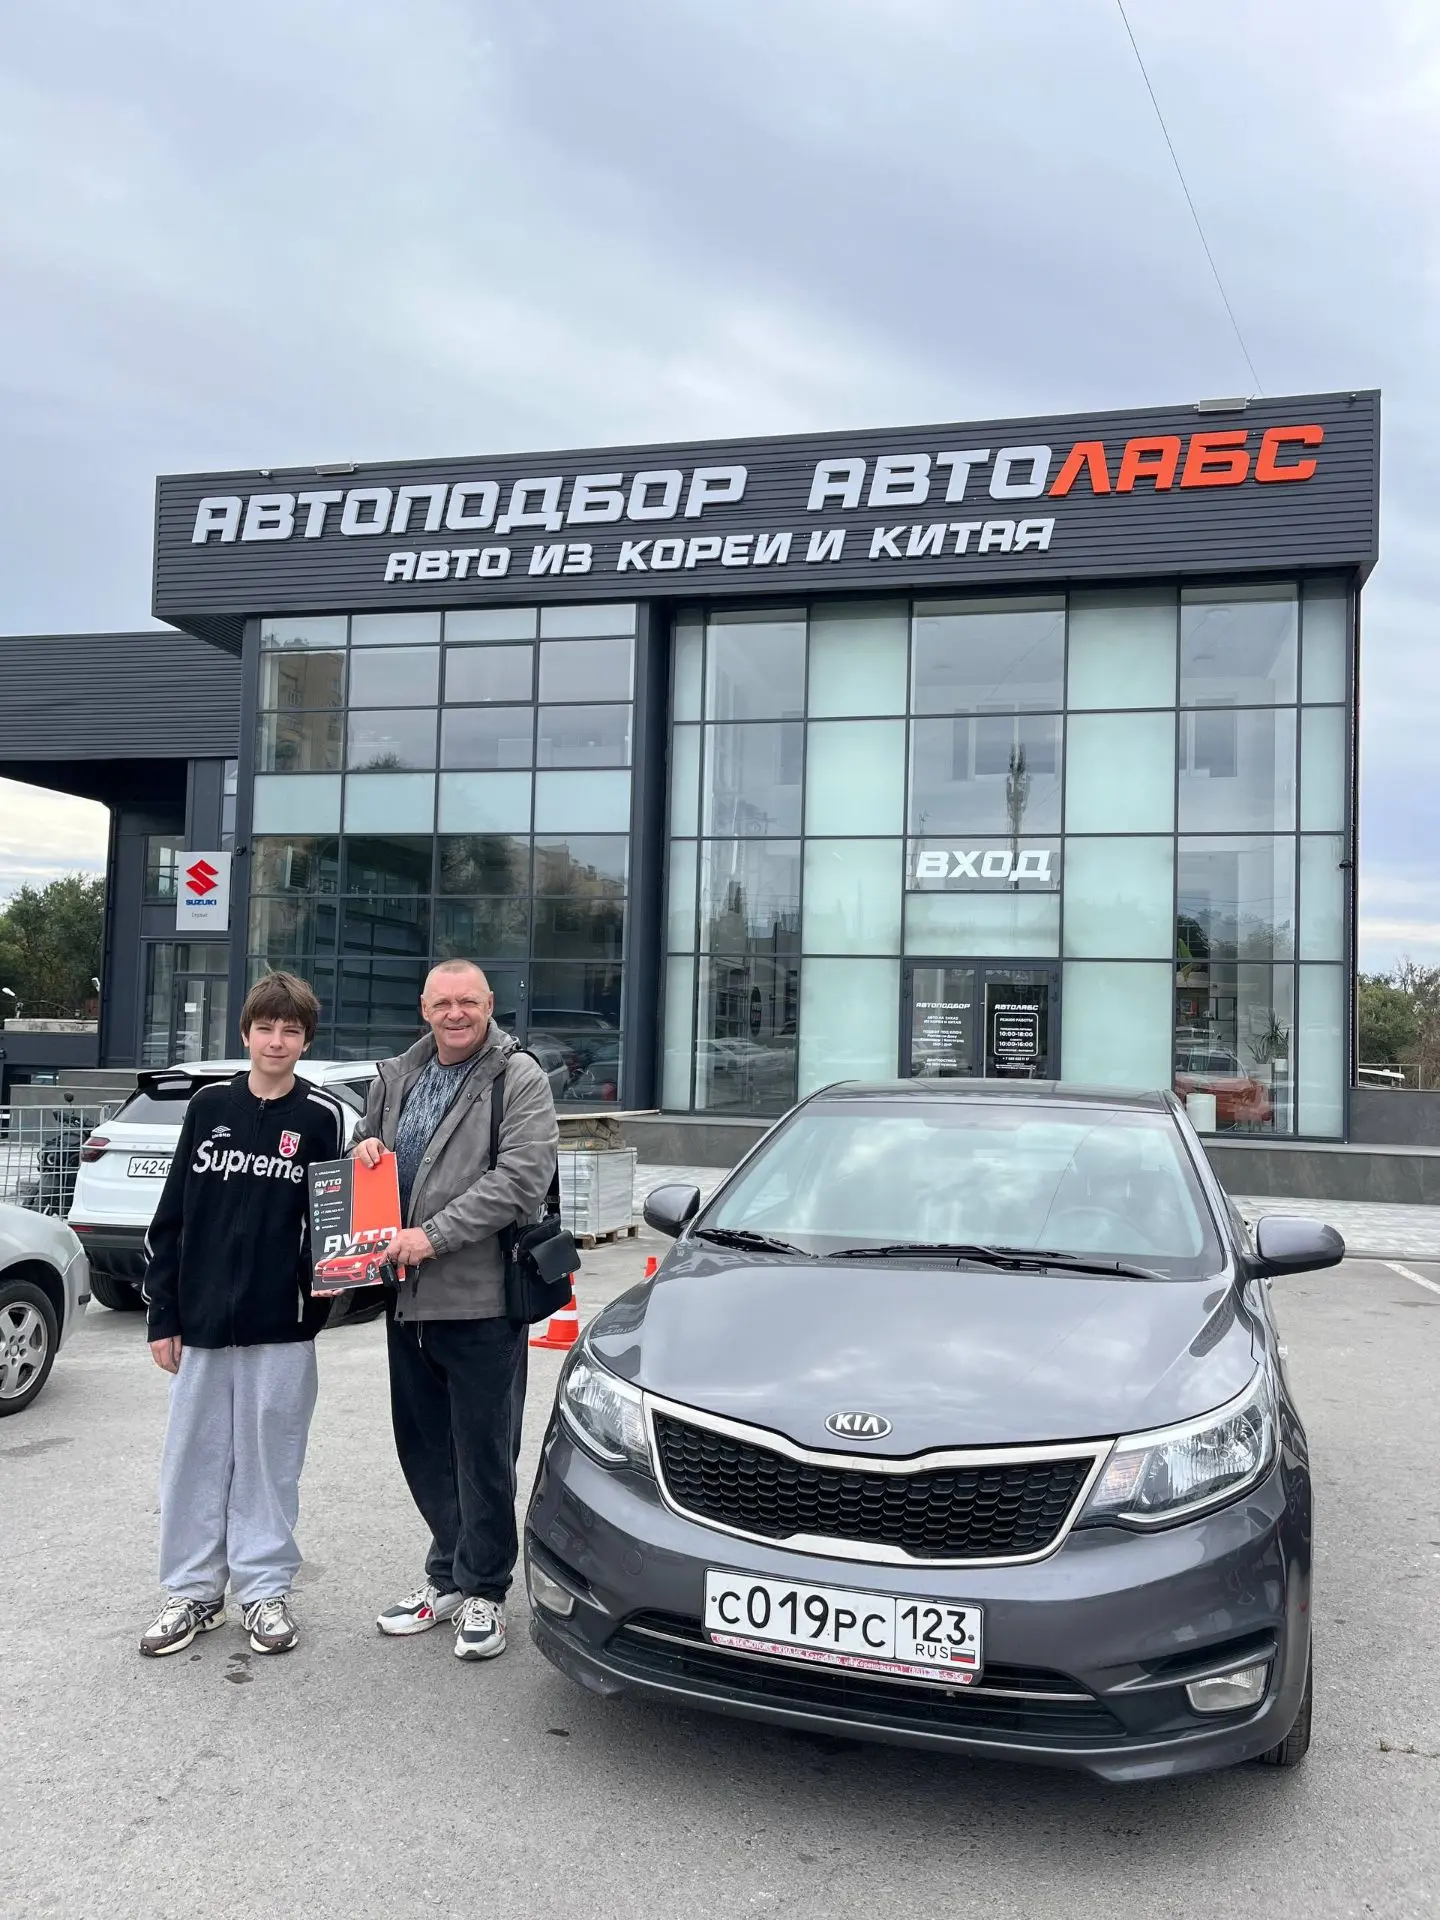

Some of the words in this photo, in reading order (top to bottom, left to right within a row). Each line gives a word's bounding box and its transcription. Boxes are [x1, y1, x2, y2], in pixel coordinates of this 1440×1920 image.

[191, 465, 748, 544] АВТОПОДБОР
[806, 424, 1325, 511] АВТОЛАБС
[384, 547, 511, 582] АВТО
[528, 543, 593, 576] ИЗ
[616, 532, 792, 572] КОРЕИ
[806, 529, 846, 563] И
[867, 518, 1055, 561] КИТАЯ
[915, 850, 1051, 882] ВХОД
[192, 1140, 305, 1184] Supreme
[314, 1178, 342, 1189] AVTO
[835, 1414, 880, 1434] KIA
[901, 1605, 967, 1646] 123
[915, 1643, 949, 1660] RUS
